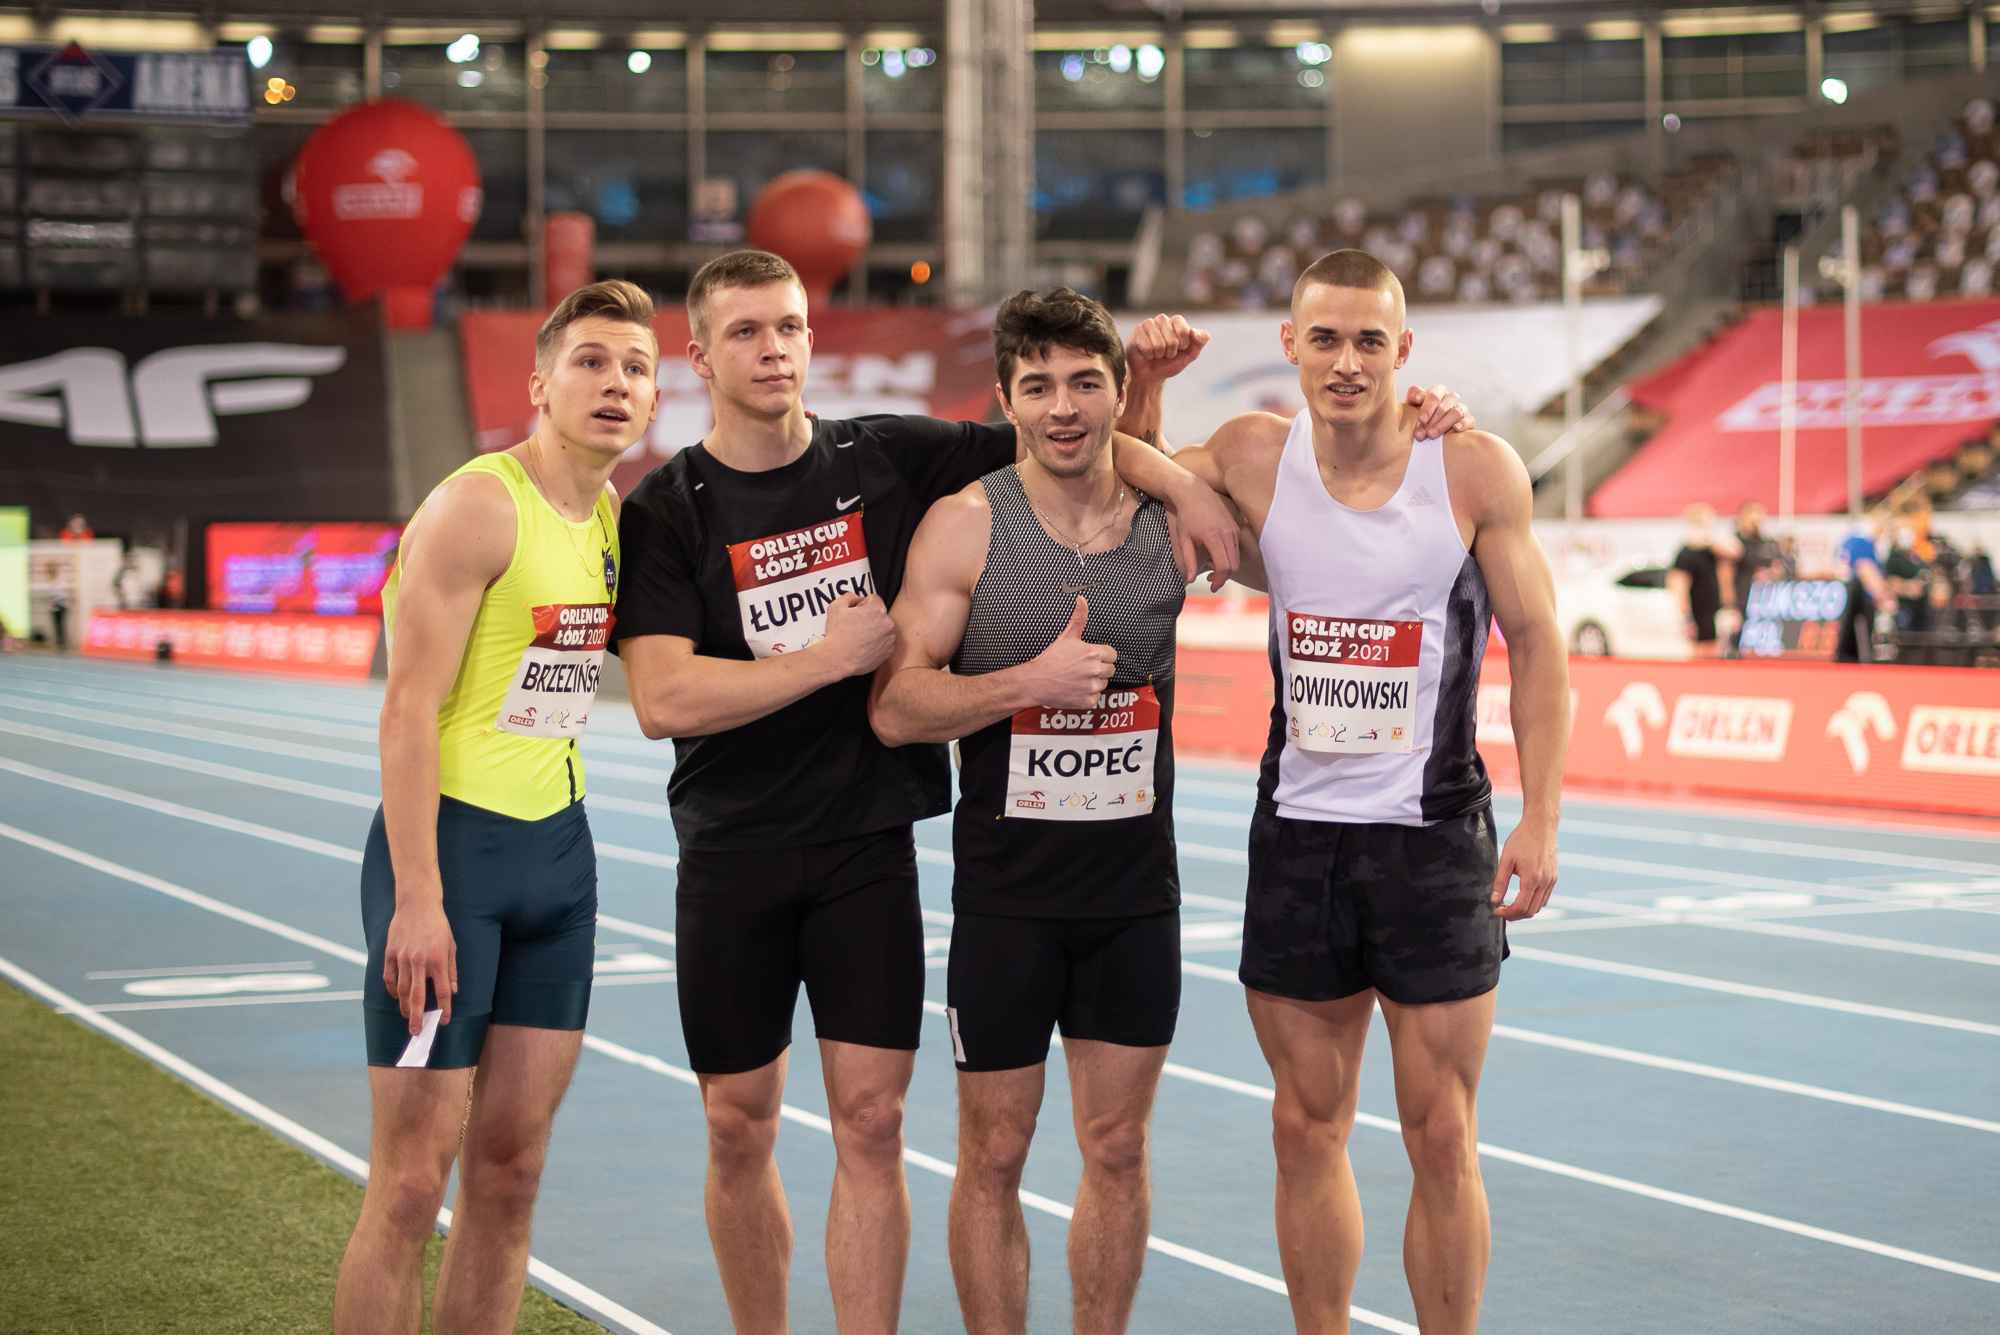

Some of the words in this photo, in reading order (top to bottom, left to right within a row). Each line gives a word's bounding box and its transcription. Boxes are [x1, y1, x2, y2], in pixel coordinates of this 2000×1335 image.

[750, 530, 814, 560] ORLEN
[814, 521, 848, 543] CUP
[755, 549, 808, 580] ŁÓDŹ
[811, 541, 850, 566] 2021
[560, 608, 593, 625] ORLEN
[553, 625, 587, 646] ŁÓDŹ
[587, 628, 606, 645] 2021
[1292, 618, 1356, 639] ORLEN
[1357, 624, 1396, 641] CUP
[1291, 635, 1343, 658] ŁÓDŹ
[1348, 643, 1390, 662] 2021
[1108, 692, 1139, 708] CUP
[509, 715, 534, 727] ORLEN
[1039, 708, 1094, 730] ŁÓDŹ
[1100, 711, 1135, 729] 2021
[1028, 738, 1144, 778] KOPEĆ
[1017, 801, 1044, 809] ORLEN
